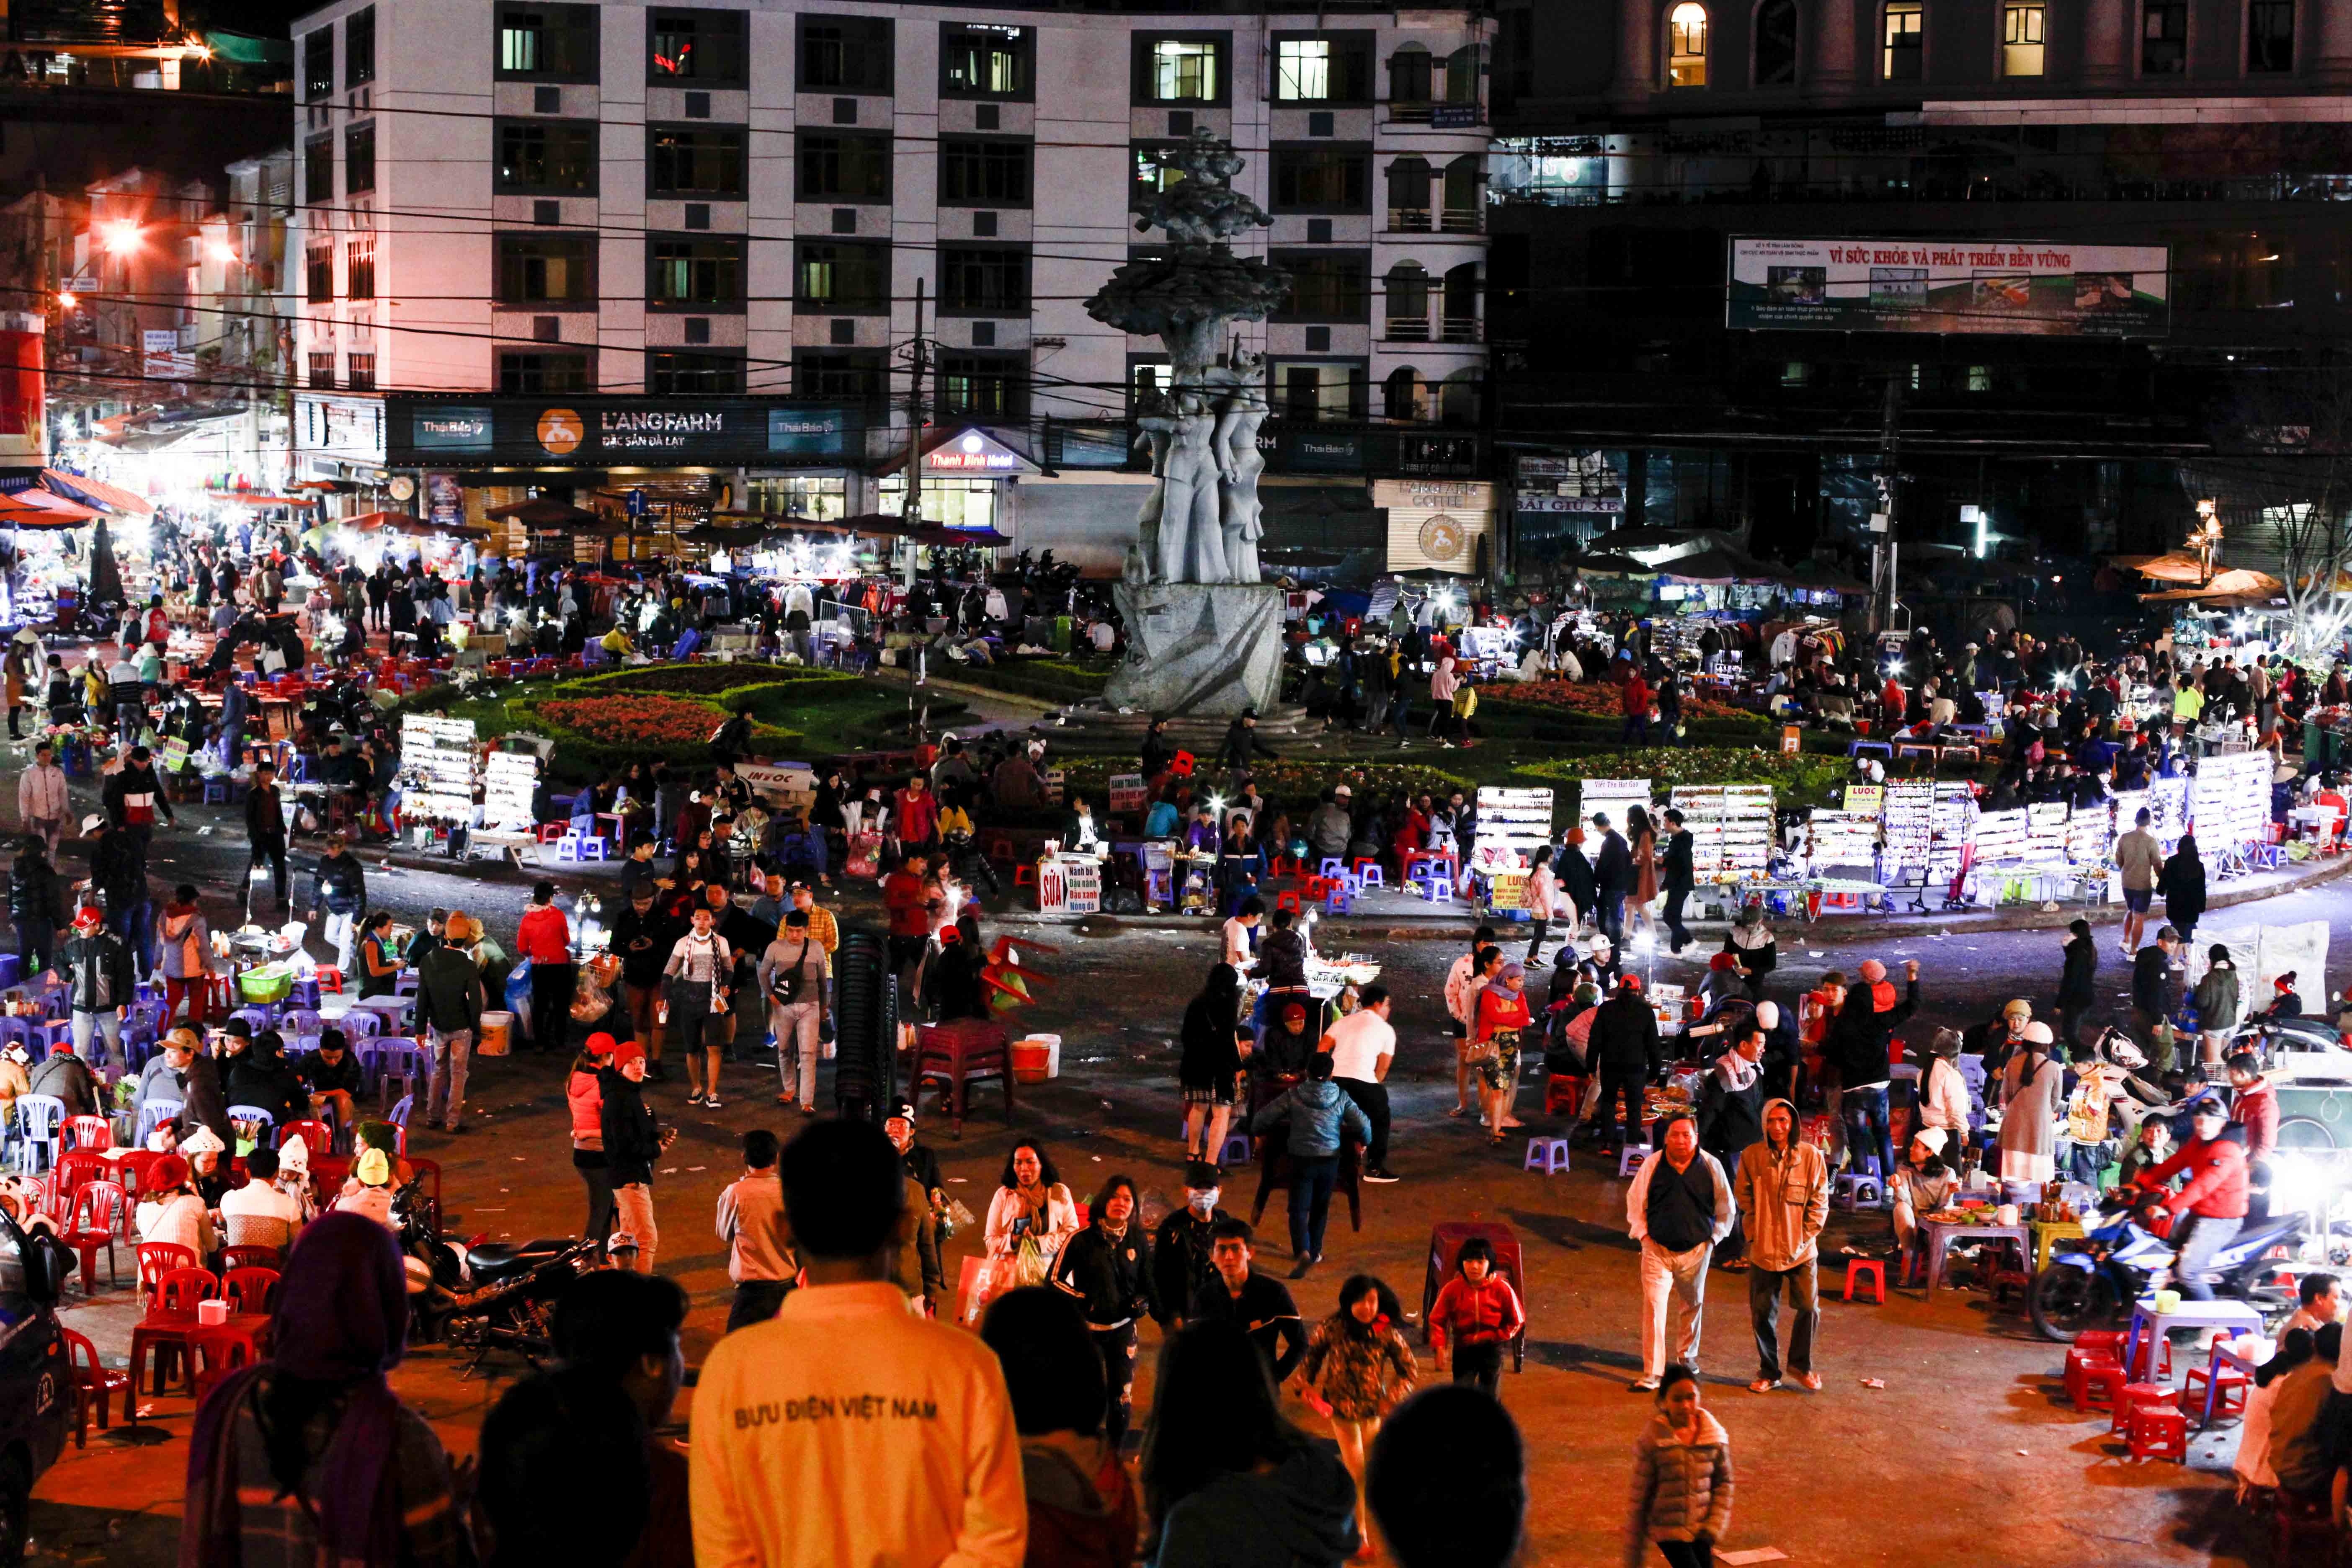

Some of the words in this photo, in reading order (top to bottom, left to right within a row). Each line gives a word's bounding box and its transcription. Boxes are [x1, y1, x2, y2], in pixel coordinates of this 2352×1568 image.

[1846, 248, 1869, 263] SỨC
[1912, 248, 1929, 265] VÀ
[1968, 245, 2005, 266] TRIỂN
[2009, 246, 2033, 267] BỀN
[2037, 249, 2071, 268] VỮNG
[665, 436, 685, 449] LẠT
[931, 454, 962, 466] Thanh
[986, 454, 1013, 466] Hotel
[1413, 495, 1463, 507] COFFEE
[1551, 499, 1588, 510] GIỮ
[1592, 501, 1618, 511] XE
[1043, 868, 1062, 906] SỮA
[1070, 878, 1081, 889] Đậu
[1070, 890, 1081, 900] Đậu
[1083, 890, 1097, 899] xanh
[1070, 902, 1086, 911] Nóng
[1087, 901, 1094, 910] đá
[902, 1104, 915, 1123] 2
[735, 1401, 780, 1430] BƯU
[785, 1395, 835, 1423] ĐIỆN
[840, 1392, 886, 1421] VIỆT
[892, 1398, 938, 1421] NAM
